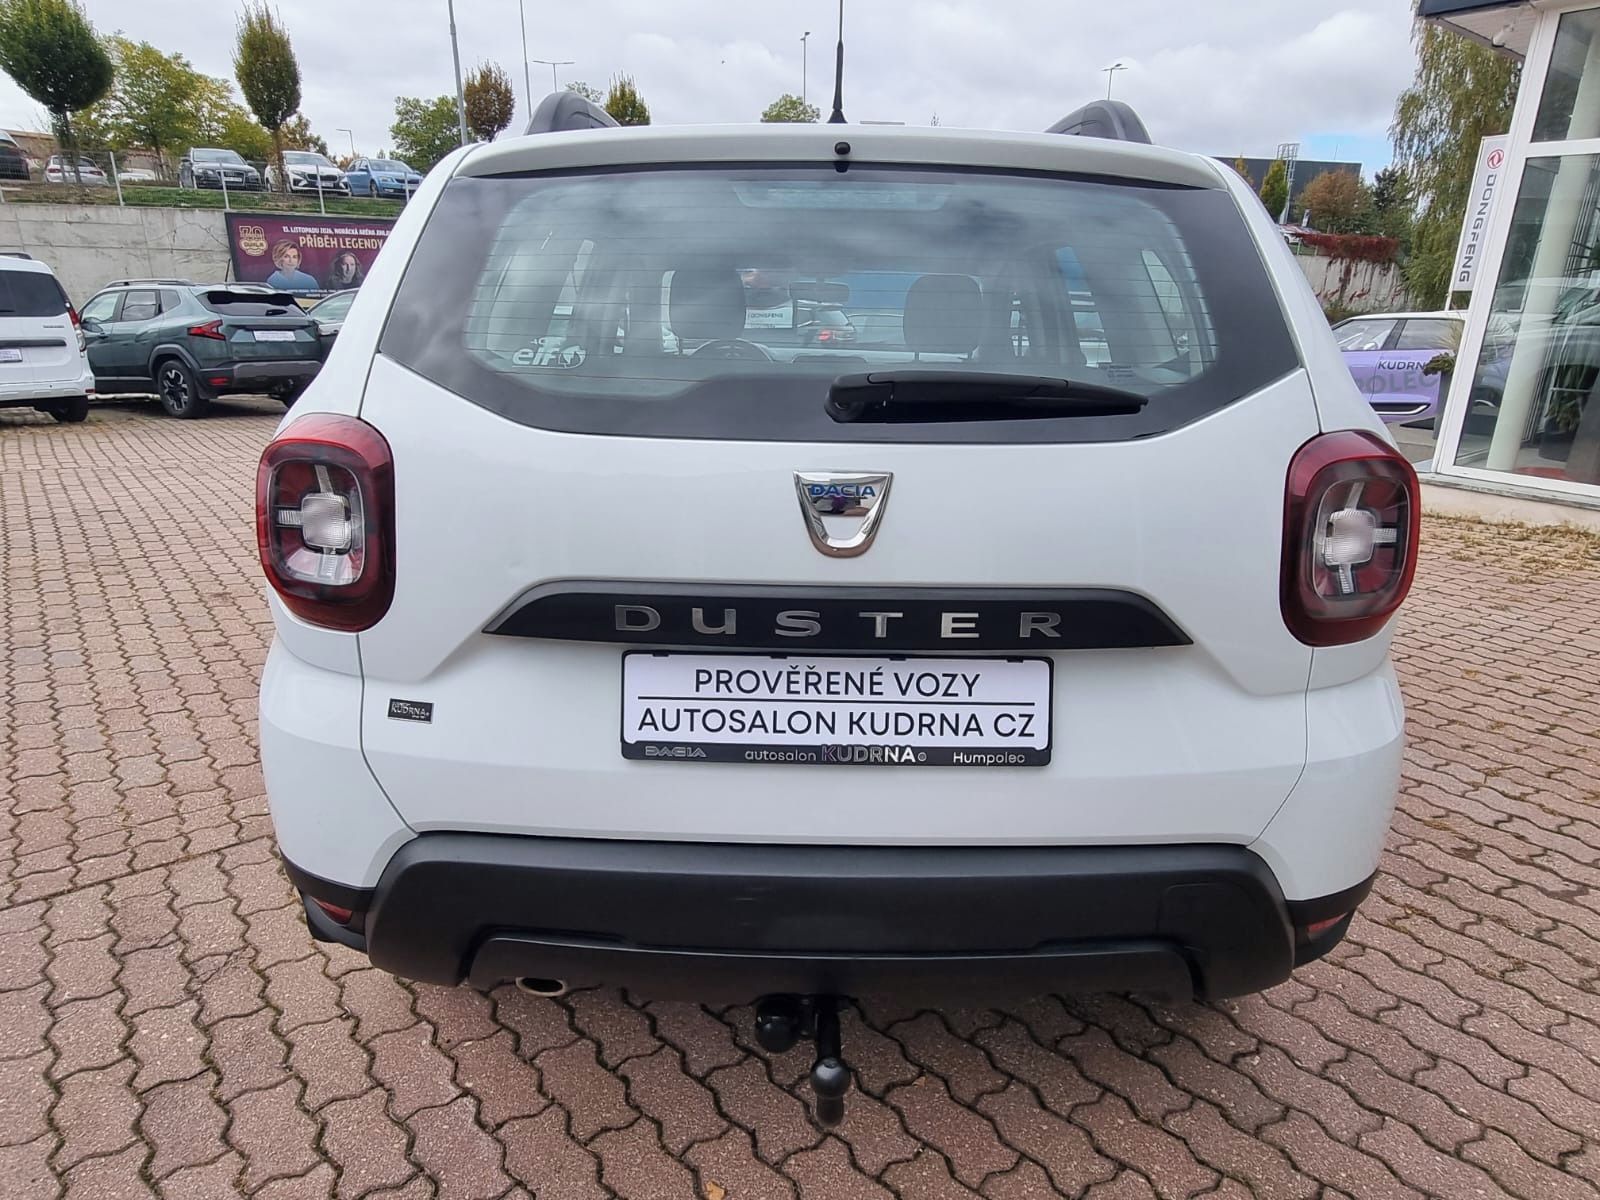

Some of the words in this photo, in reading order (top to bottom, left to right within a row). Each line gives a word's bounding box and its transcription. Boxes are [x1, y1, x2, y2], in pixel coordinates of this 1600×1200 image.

[1459, 174, 1497, 282] DONGFENG
[300, 234, 338, 249] PŘÍBĚH
[340, 237, 384, 250] LEGENDY
[1378, 360, 1426, 370] KUDRN
[810, 484, 876, 498] DACIA
[615, 604, 1062, 639] DUSTER
[695, 665, 884, 697] PROVĚŘENÉ
[893, 671, 981, 698] VOZY
[638, 707, 837, 736] AUTOSALON
[848, 711, 984, 738] KUDRNA
[993, 712, 1035, 738] CZ
[645, 745, 707, 758] DACIA
[744, 749, 817, 762] autosalon
[821, 744, 916, 763] KUDRNA
[952, 751, 1025, 766] Humpolec
